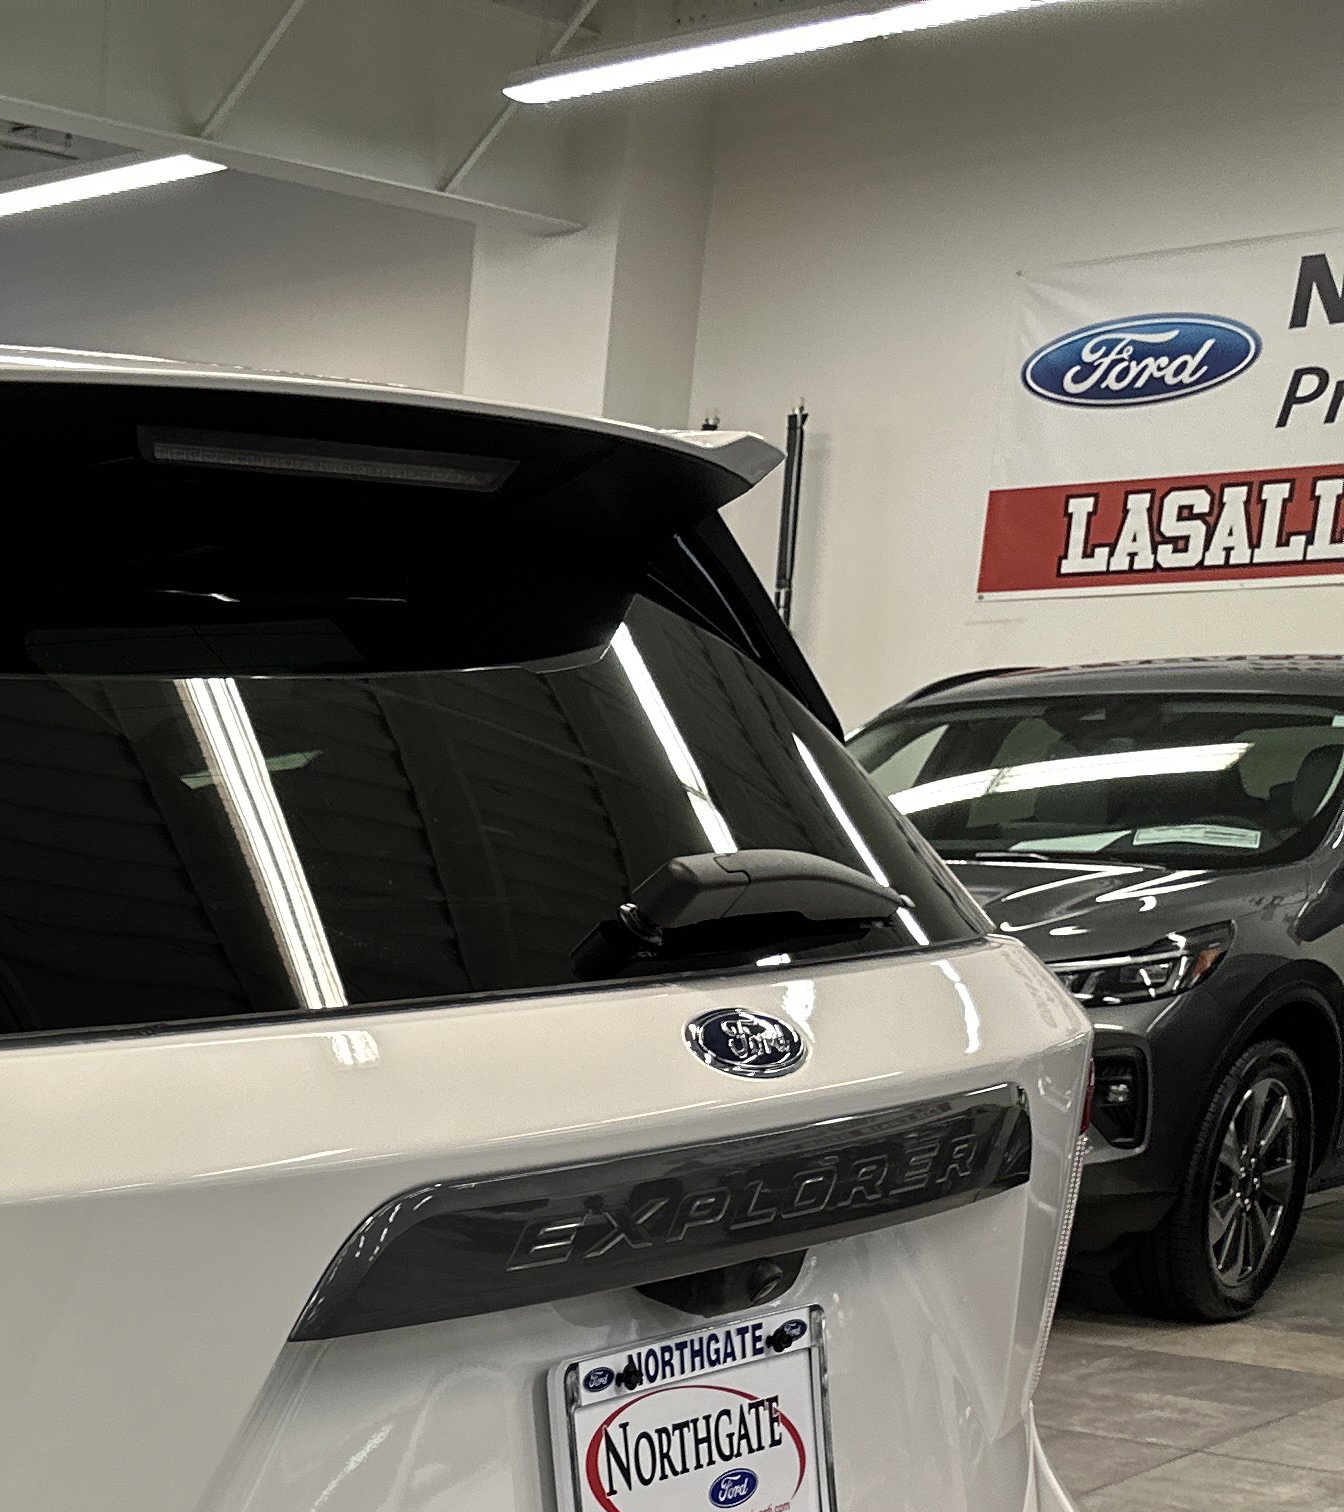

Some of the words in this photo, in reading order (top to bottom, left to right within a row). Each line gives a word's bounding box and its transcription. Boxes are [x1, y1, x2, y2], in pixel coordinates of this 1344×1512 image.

[1062, 329, 1217, 395] Ford
[506, 1133, 978, 1272] EXPLORER
[604, 1395, 783, 1498] NORTHGATE
